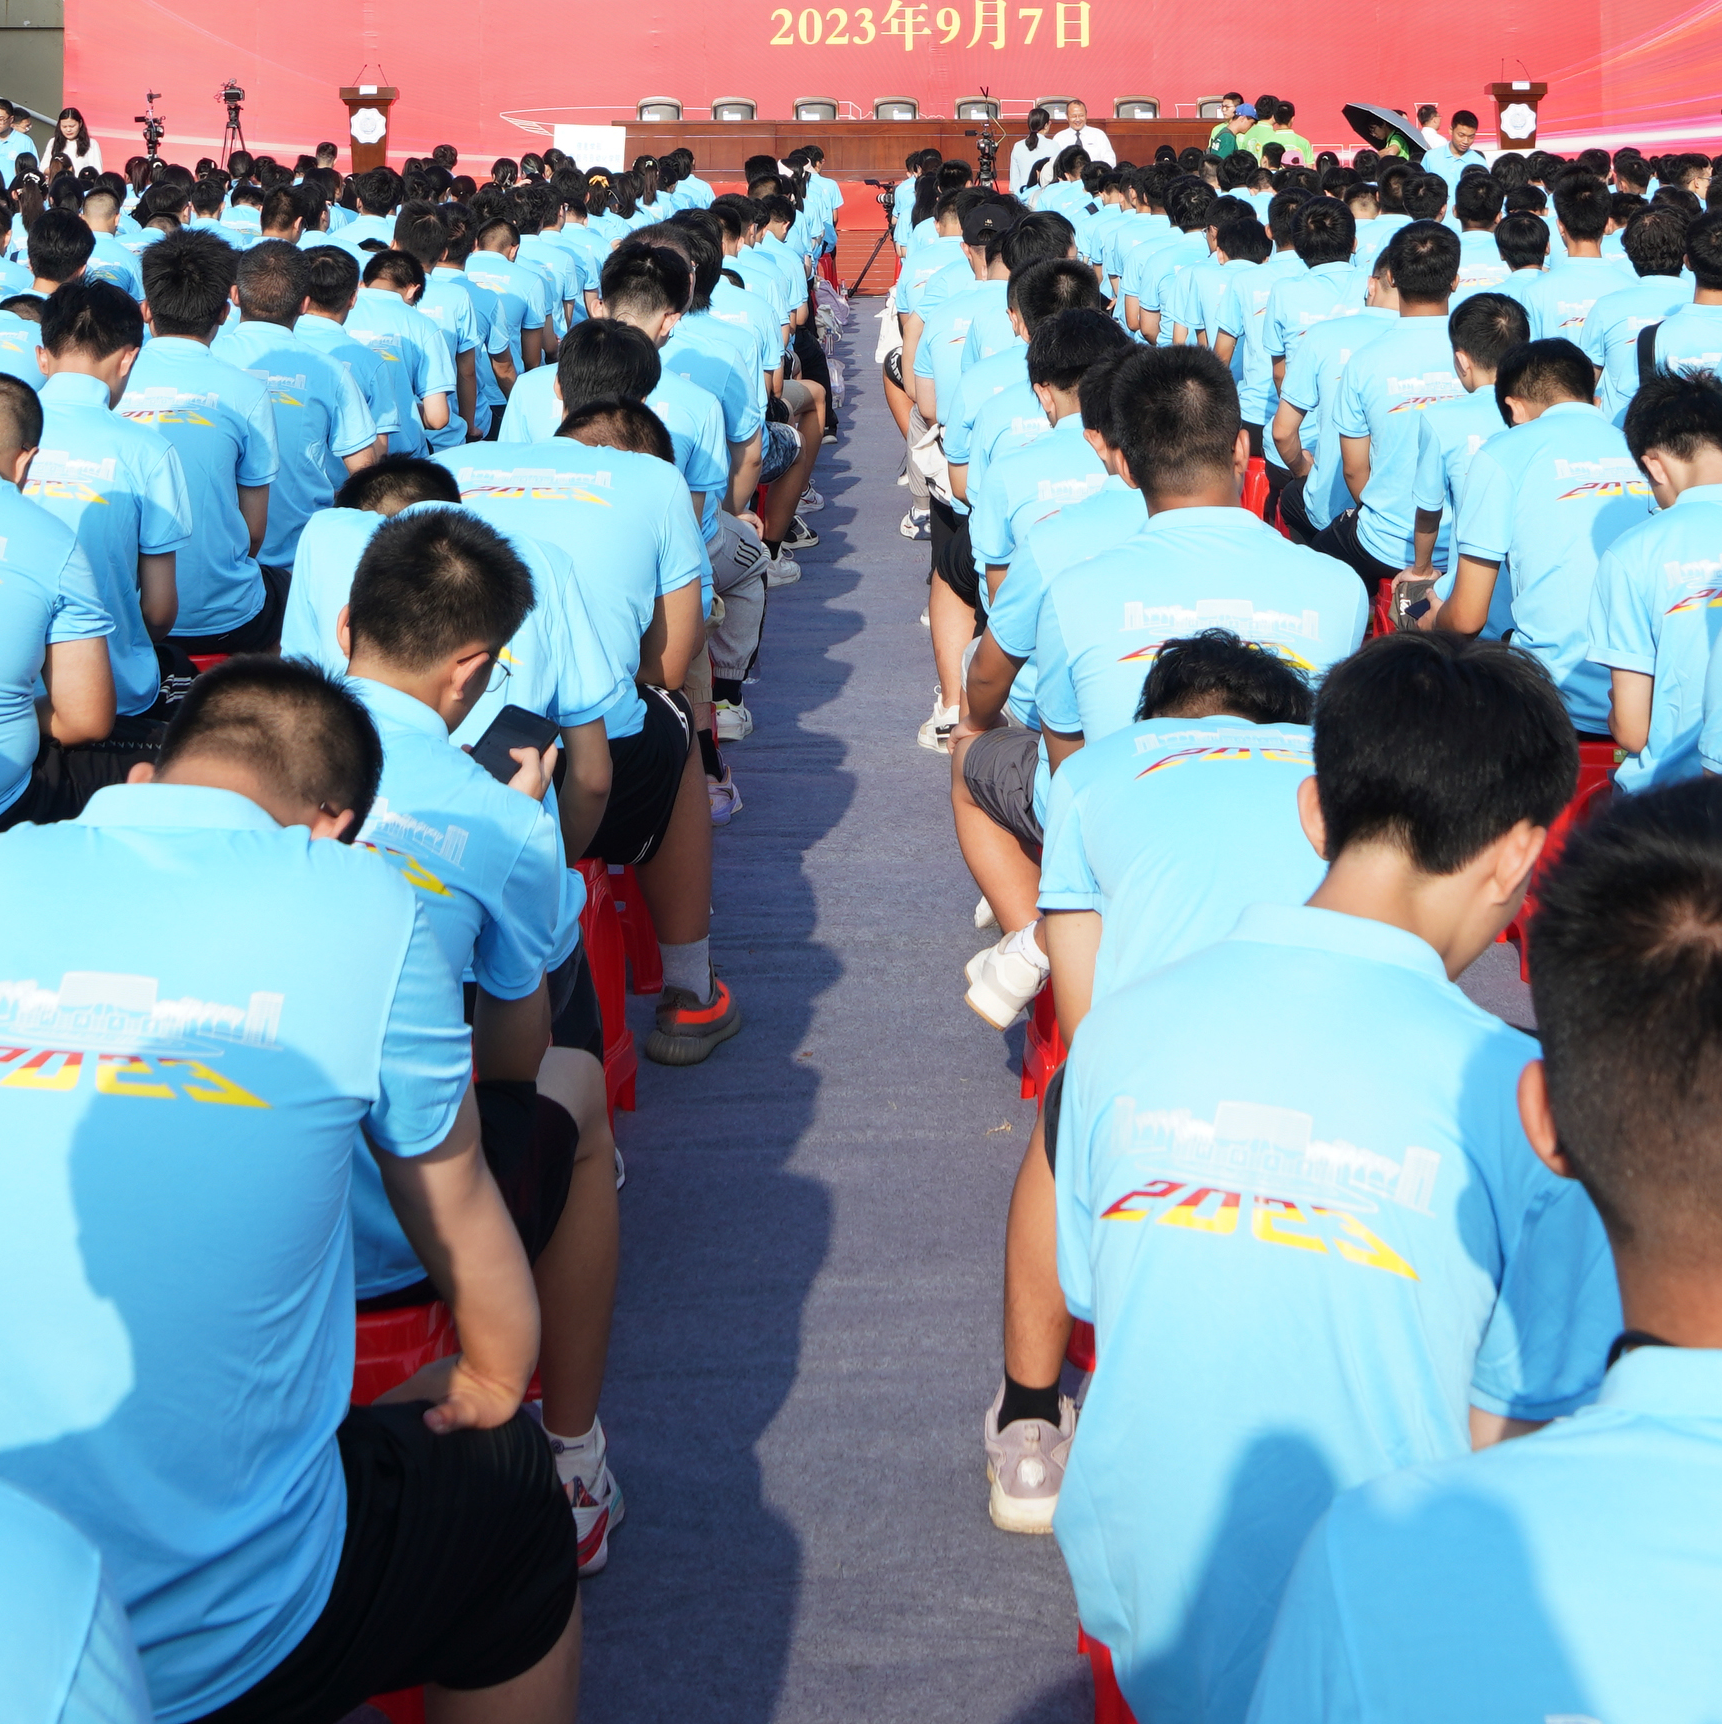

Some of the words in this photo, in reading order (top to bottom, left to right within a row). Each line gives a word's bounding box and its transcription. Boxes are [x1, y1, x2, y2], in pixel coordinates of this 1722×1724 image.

[770, 0, 1092, 52] 2023年9月7日
[458, 486, 613, 508] 2023
[1555, 480, 1654, 501] 202
[1099, 1178, 1423, 1284] 2023
